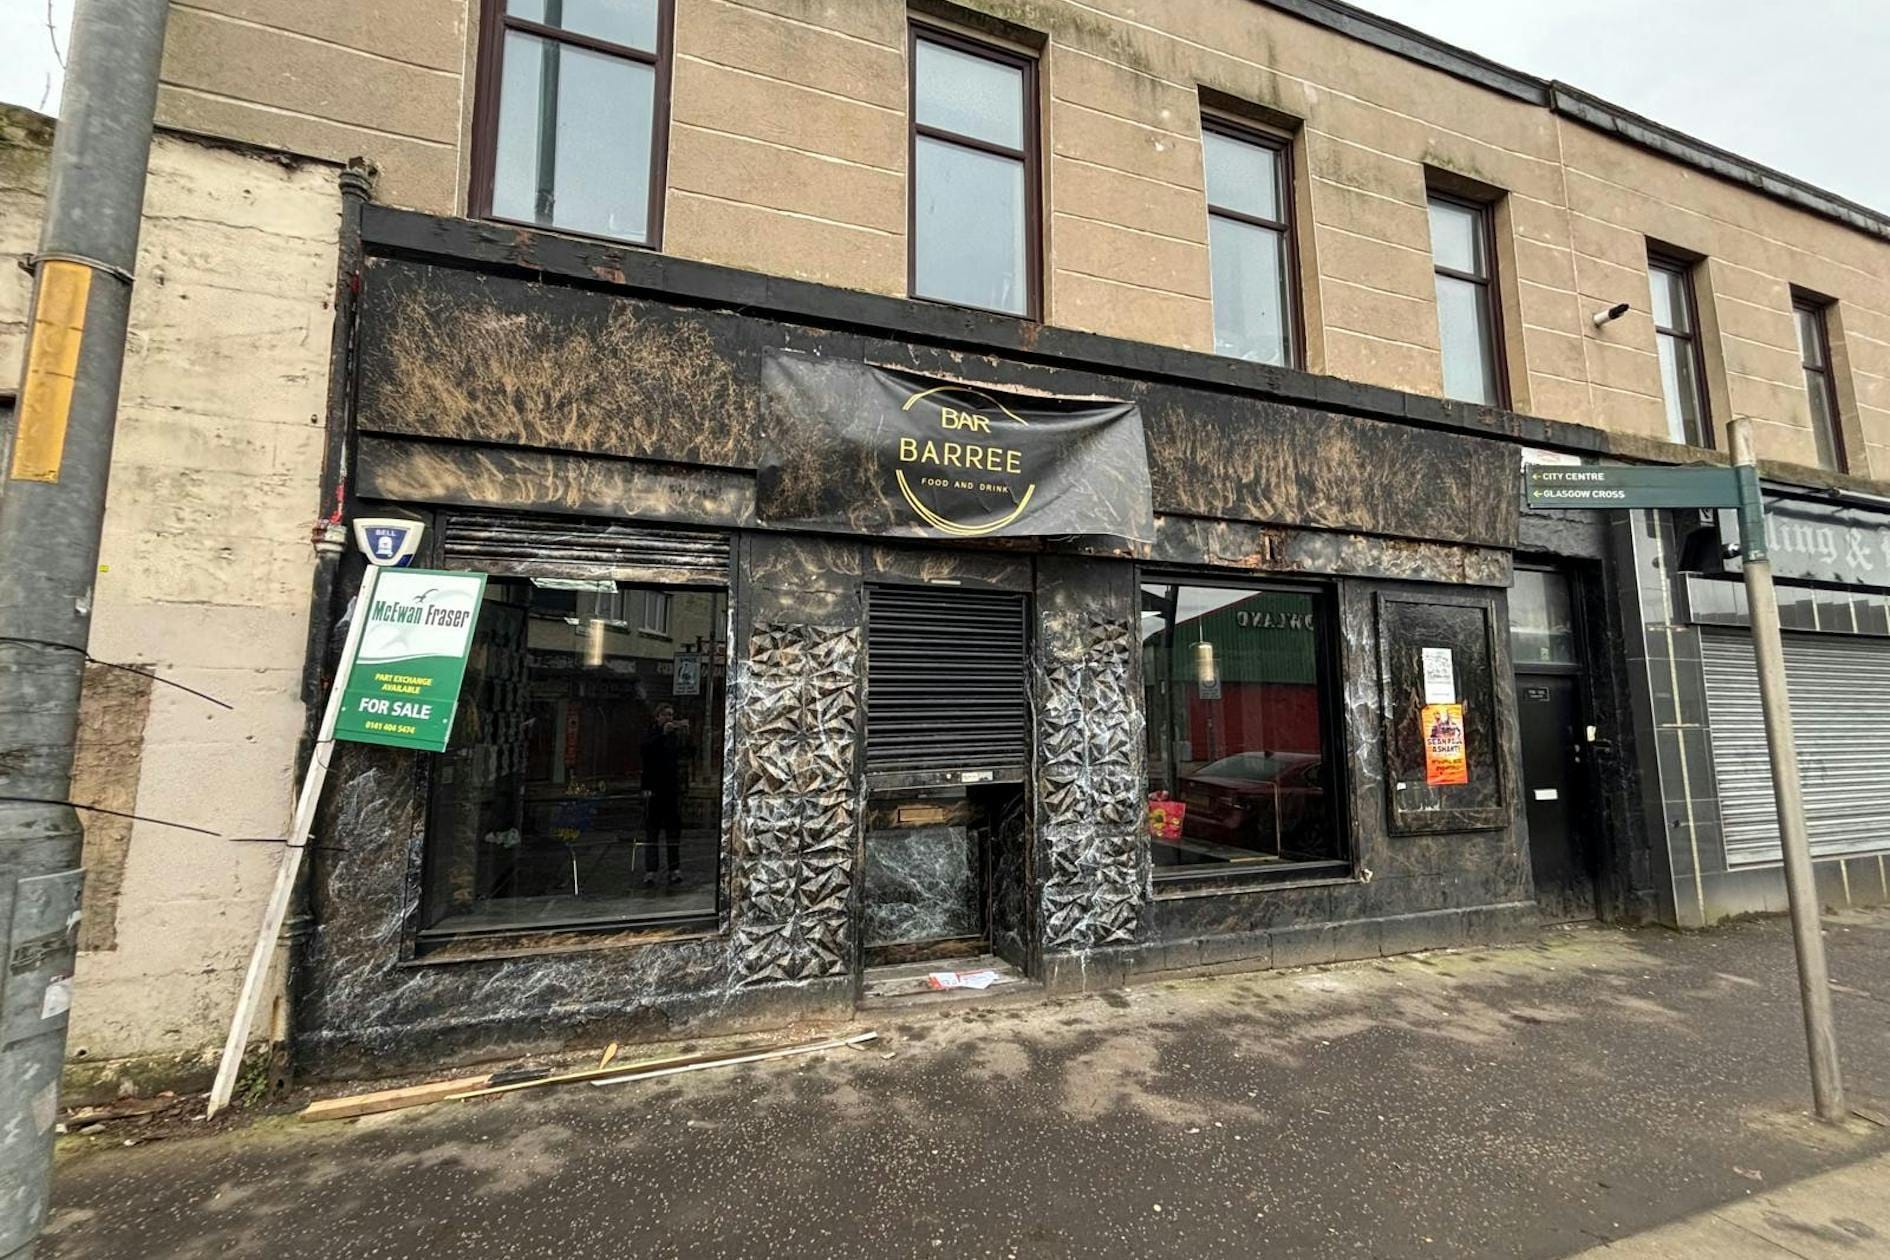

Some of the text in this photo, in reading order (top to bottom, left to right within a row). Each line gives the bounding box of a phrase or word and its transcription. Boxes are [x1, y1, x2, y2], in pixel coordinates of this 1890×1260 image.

[941, 407, 991, 433] BAR
[900, 437, 1022, 474] BARREE
[1542, 472, 1606, 481] CITY CENTRE
[921, 477, 1009, 493] FOOD AND DRINK
[1543, 489, 1626, 499] GLASGOW CROSS
[375, 529, 397, 537] BELL
[1766, 512, 1838, 565] ling
[371, 600, 470, 628] McEwan Fraser
[374, 673, 433, 687] PART EXCHANGE
[381, 683, 421, 694] AVAILABLE
[358, 697, 432, 720] FOR SALE
